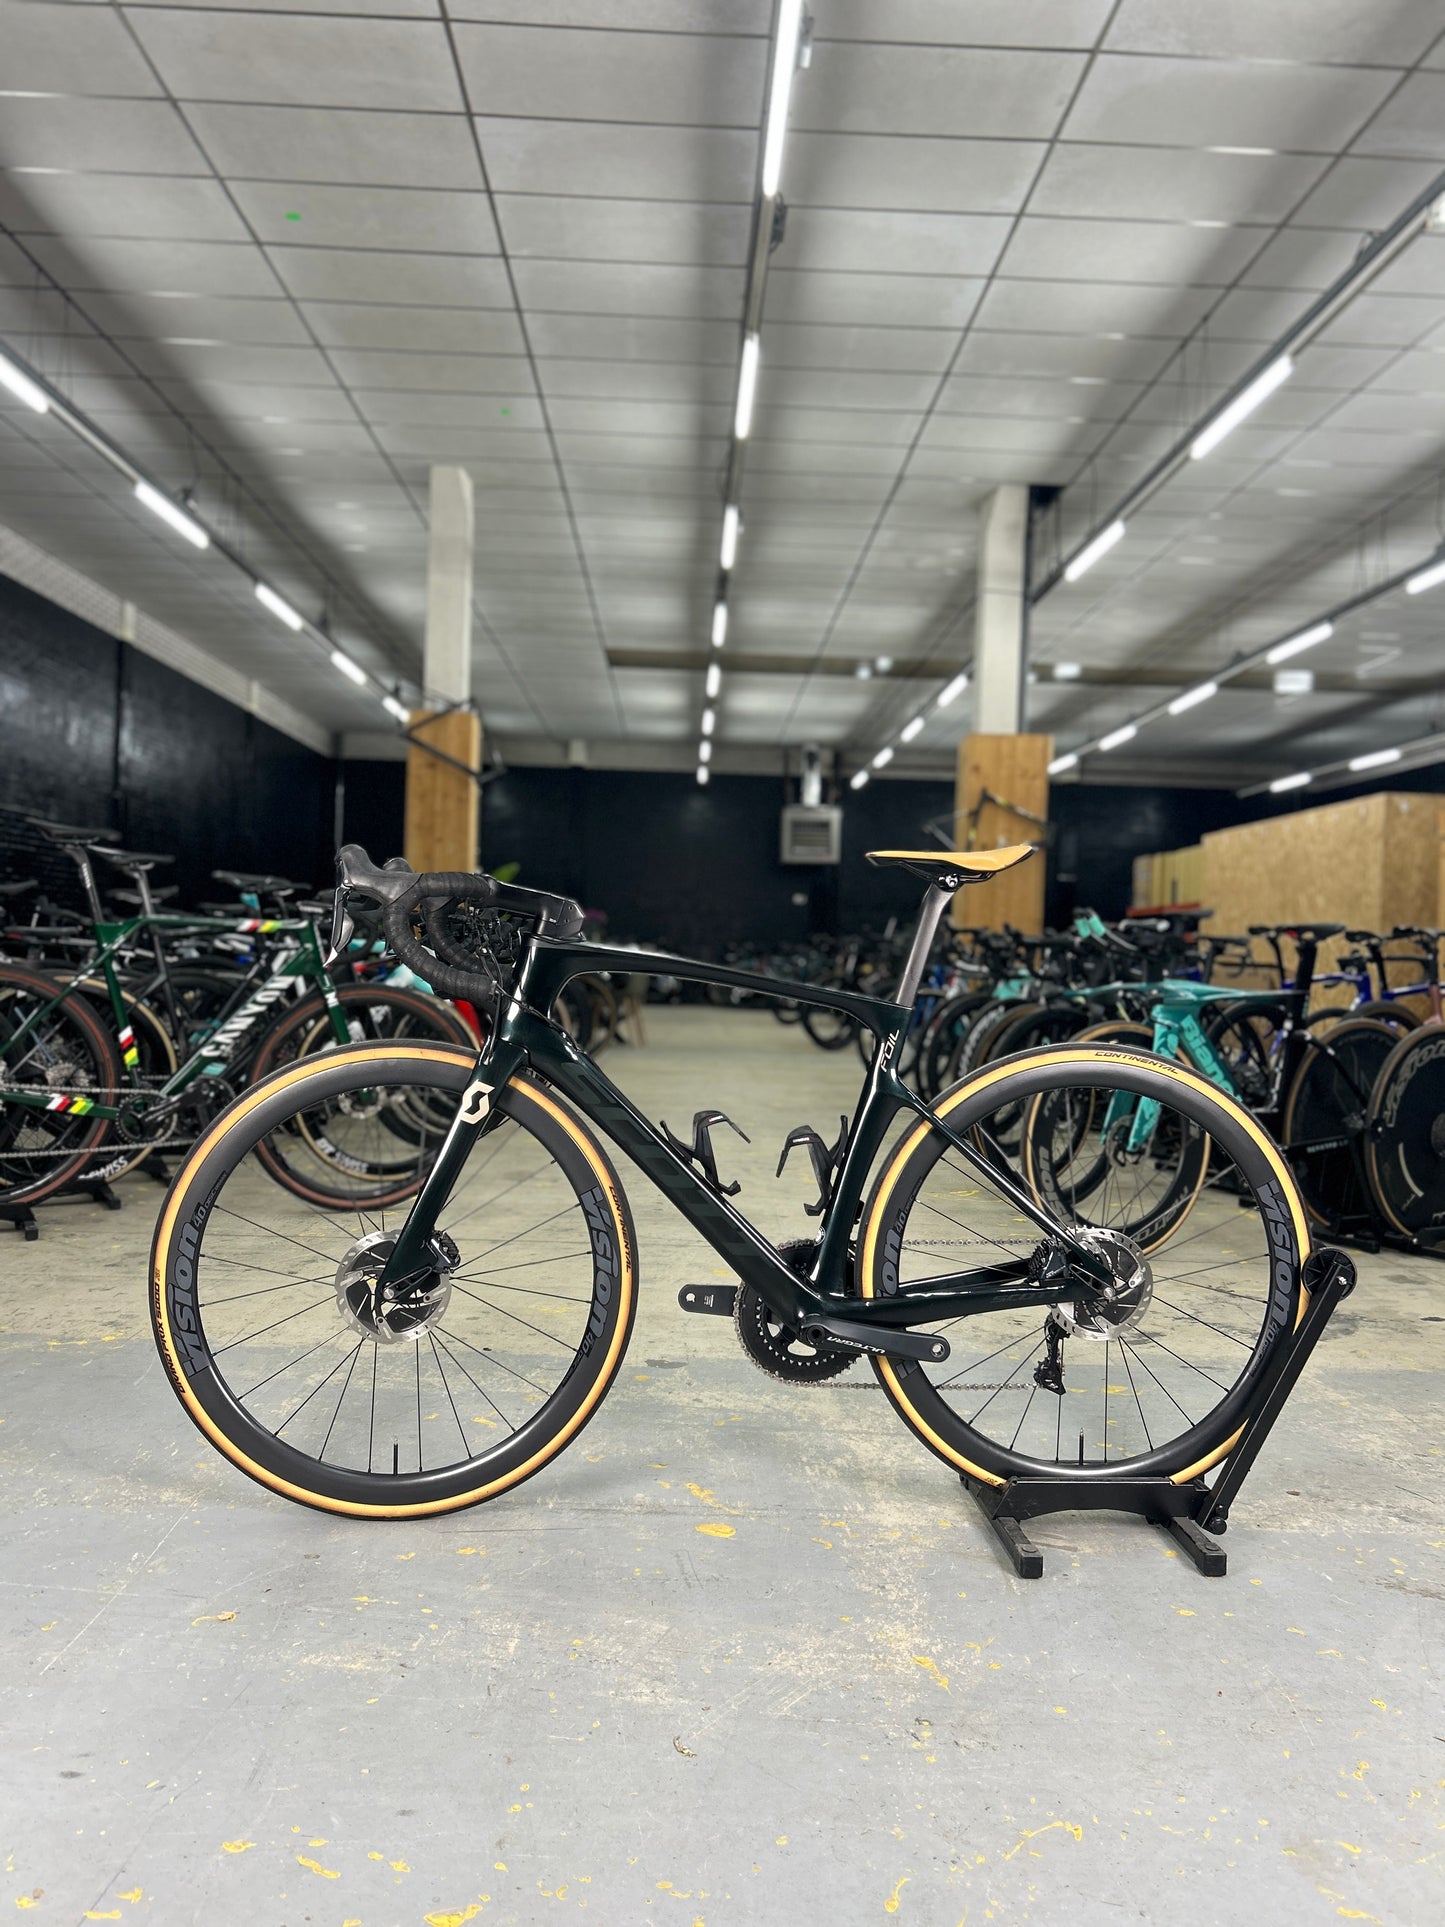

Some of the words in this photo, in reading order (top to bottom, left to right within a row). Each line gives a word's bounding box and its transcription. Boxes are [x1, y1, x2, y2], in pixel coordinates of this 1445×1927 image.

[201, 976, 295, 1057] CANYON
[880, 1029, 900, 1073] FOIL
[1094, 1051, 1179, 1075] CONTINENTAL
[557, 1062, 768, 1260] SCOTT
[608, 1185, 632, 1274] CONTINENTAL
[580, 1186, 619, 1338] Vision
[1256, 1178, 1299, 1327] Vision
[153, 1281, 163, 1320] 5000
[167, 1222, 210, 1378] Vision
[193, 1203, 207, 1228] 40
[157, 1320, 170, 1353] PRIX
[582, 1332, 594, 1355] 40
[826, 1335, 886, 1355] ULTEGRA
[1266, 1322, 1279, 1345] 40
[165, 1353, 187, 1395] GRAND
